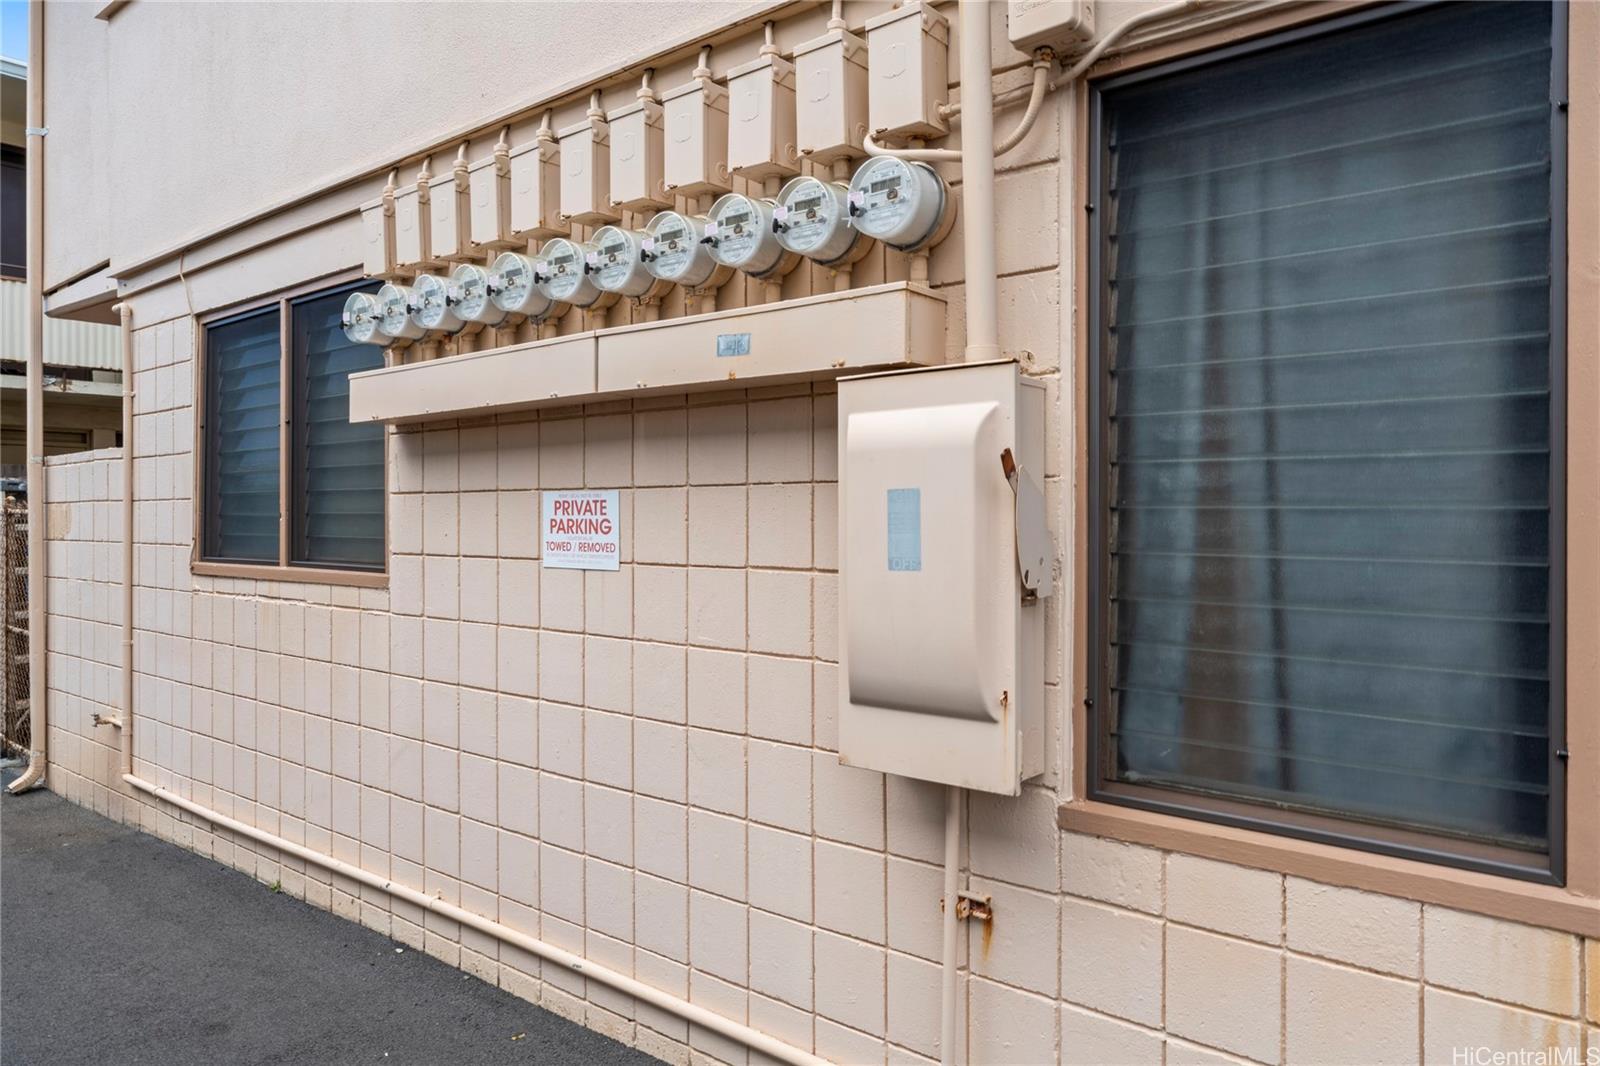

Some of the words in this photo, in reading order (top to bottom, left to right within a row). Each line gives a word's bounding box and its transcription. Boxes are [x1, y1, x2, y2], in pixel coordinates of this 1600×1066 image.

[554, 499, 607, 516] PRIVATE
[550, 518, 612, 535] PARKING
[545, 541, 572, 552] TOWED
[578, 542, 616, 553] REMOVED
